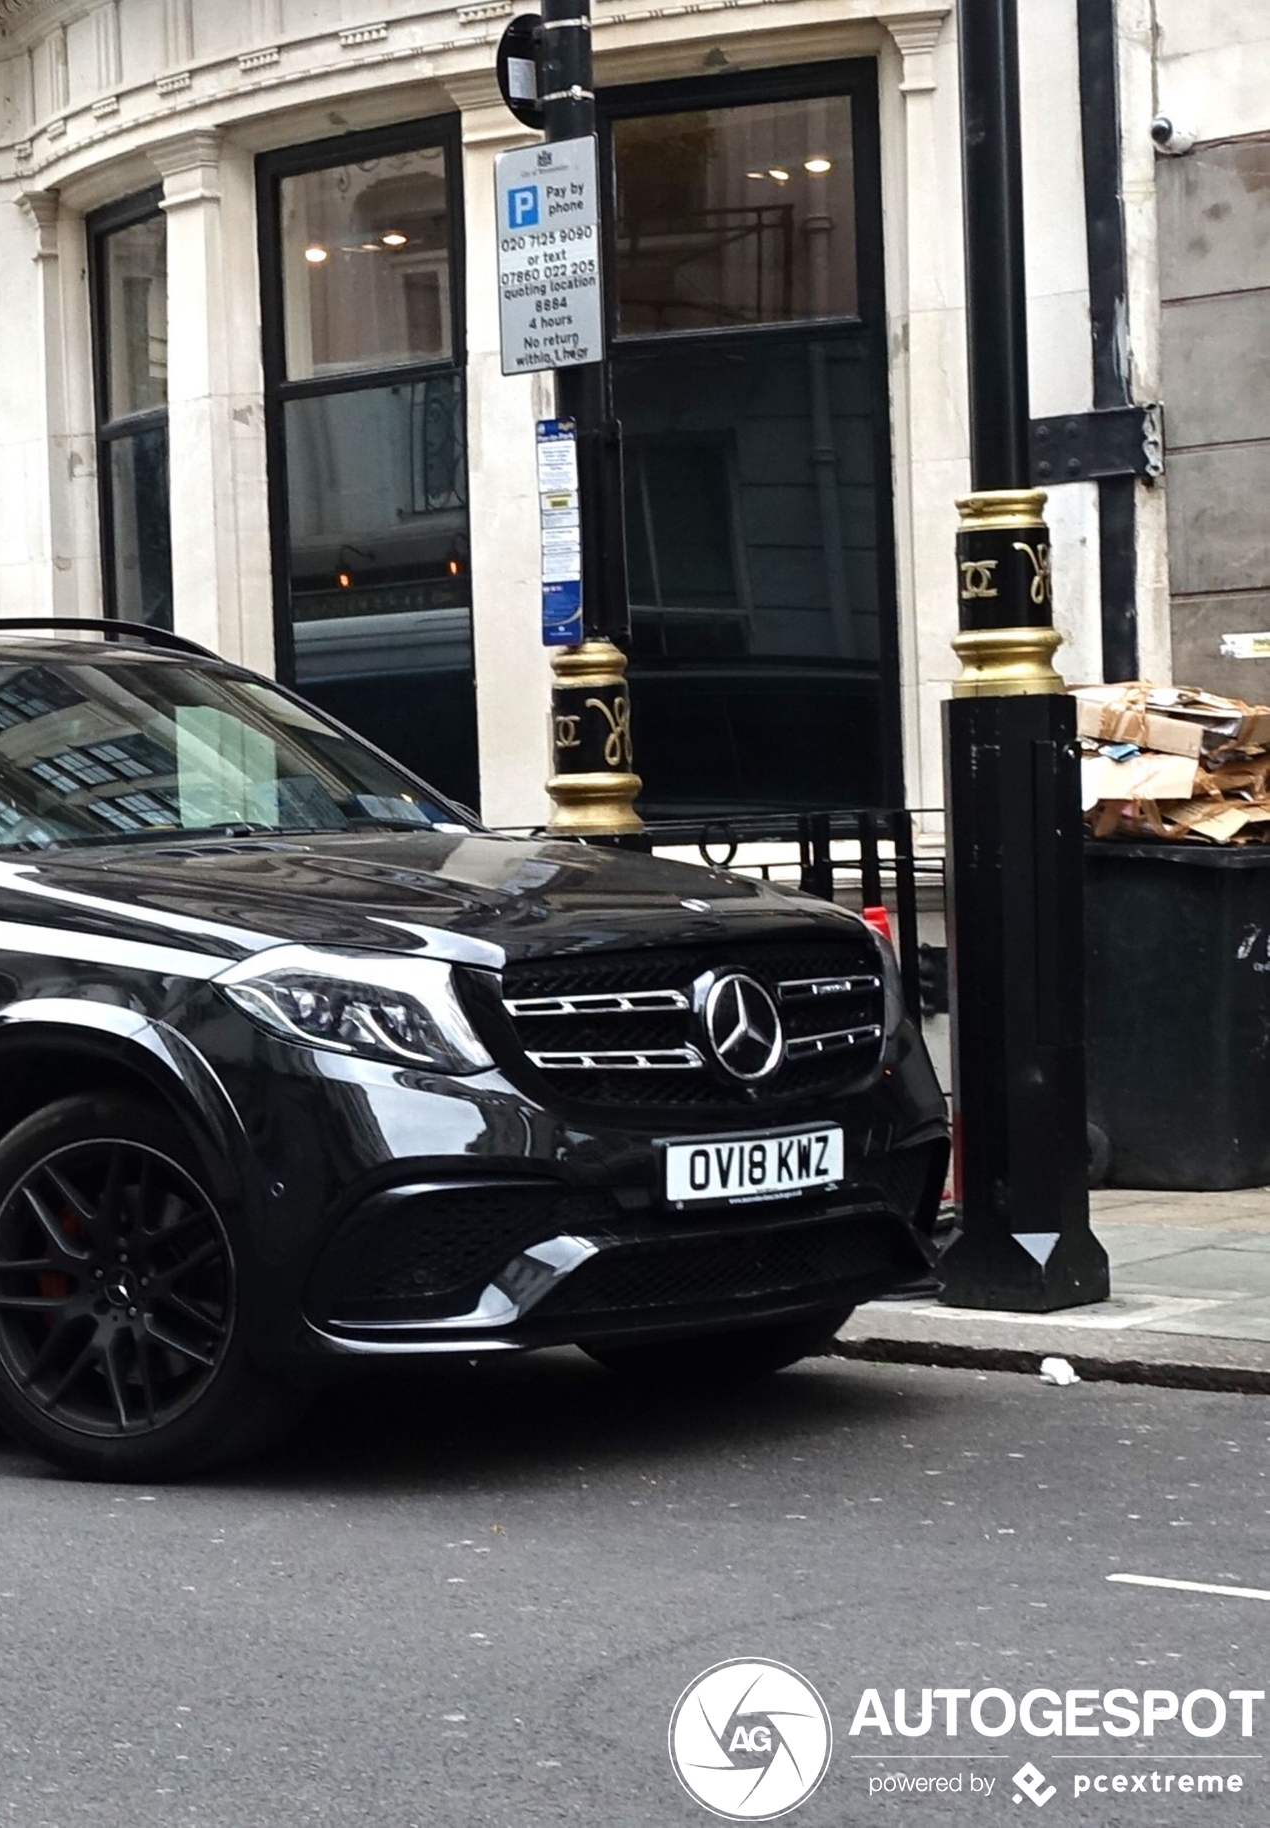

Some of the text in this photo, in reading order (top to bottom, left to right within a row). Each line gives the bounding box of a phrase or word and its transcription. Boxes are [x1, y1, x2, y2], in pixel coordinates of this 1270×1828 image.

[546, 182, 584, 199] Pay by
[515, 191, 534, 225] P
[548, 200, 584, 217] phone
[501, 225, 592, 252] 020 7125 9090
[527, 249, 567, 266] or text
[502, 260, 595, 286] 07860 022 205
[504, 275, 596, 301] quoting location
[535, 296, 568, 312] 8884
[529, 315, 573, 329] 4 hours
[524, 332, 579, 350] No return
[689, 1135, 830, 1191] OV18 KWZ
